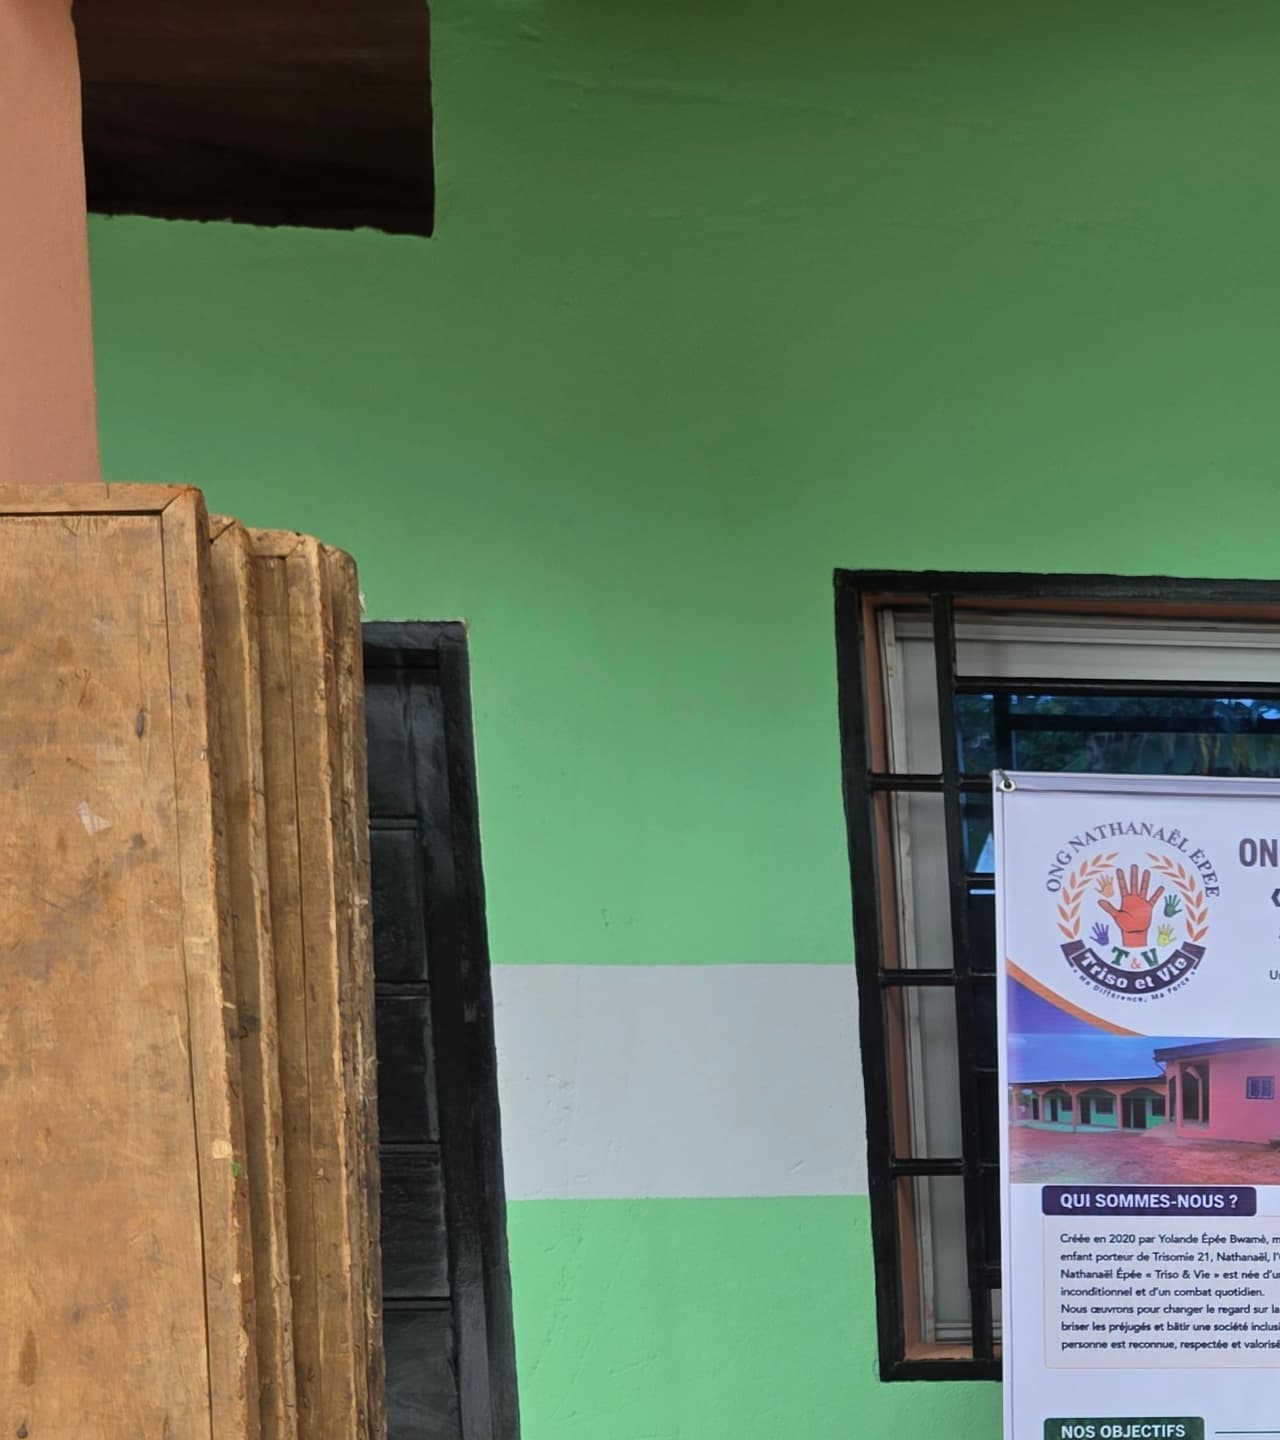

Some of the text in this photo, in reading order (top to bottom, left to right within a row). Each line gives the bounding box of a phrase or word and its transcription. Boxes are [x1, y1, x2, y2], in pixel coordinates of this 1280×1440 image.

[1046, 850, 1072, 893] ONG
[1068, 821, 1192, 853] NATHANAËL
[1111, 946, 1130, 966] T
[1141, 948, 1159, 967] V
[1081, 951, 1187, 990] Triso et Vie
[1060, 1193, 1237, 1208] QUI SOMMES-NOUS ?
[1059, 1233, 1090, 1243] Créée
[1108, 1233, 1136, 1243] 2020
[1138, 1236, 1156, 1246] par
[1157, 1233, 1198, 1243] Yolande
[1201, 1232, 1227, 1246] Épée
[1229, 1233, 1269, 1244] Bwamè,
[1060, 1250, 1092, 1261] enfant
[1095, 1253, 1134, 1263] porteur
[1136, 1251, 1150, 1261] de
[1151, 1251, 1194, 1261] Trisomie
[1197, 1251, 1213, 1262] 21,
[1216, 1251, 1270, 1262] Nathanaël,
[1061, 1424, 1185, 1438] NOS OBJECTIFS
